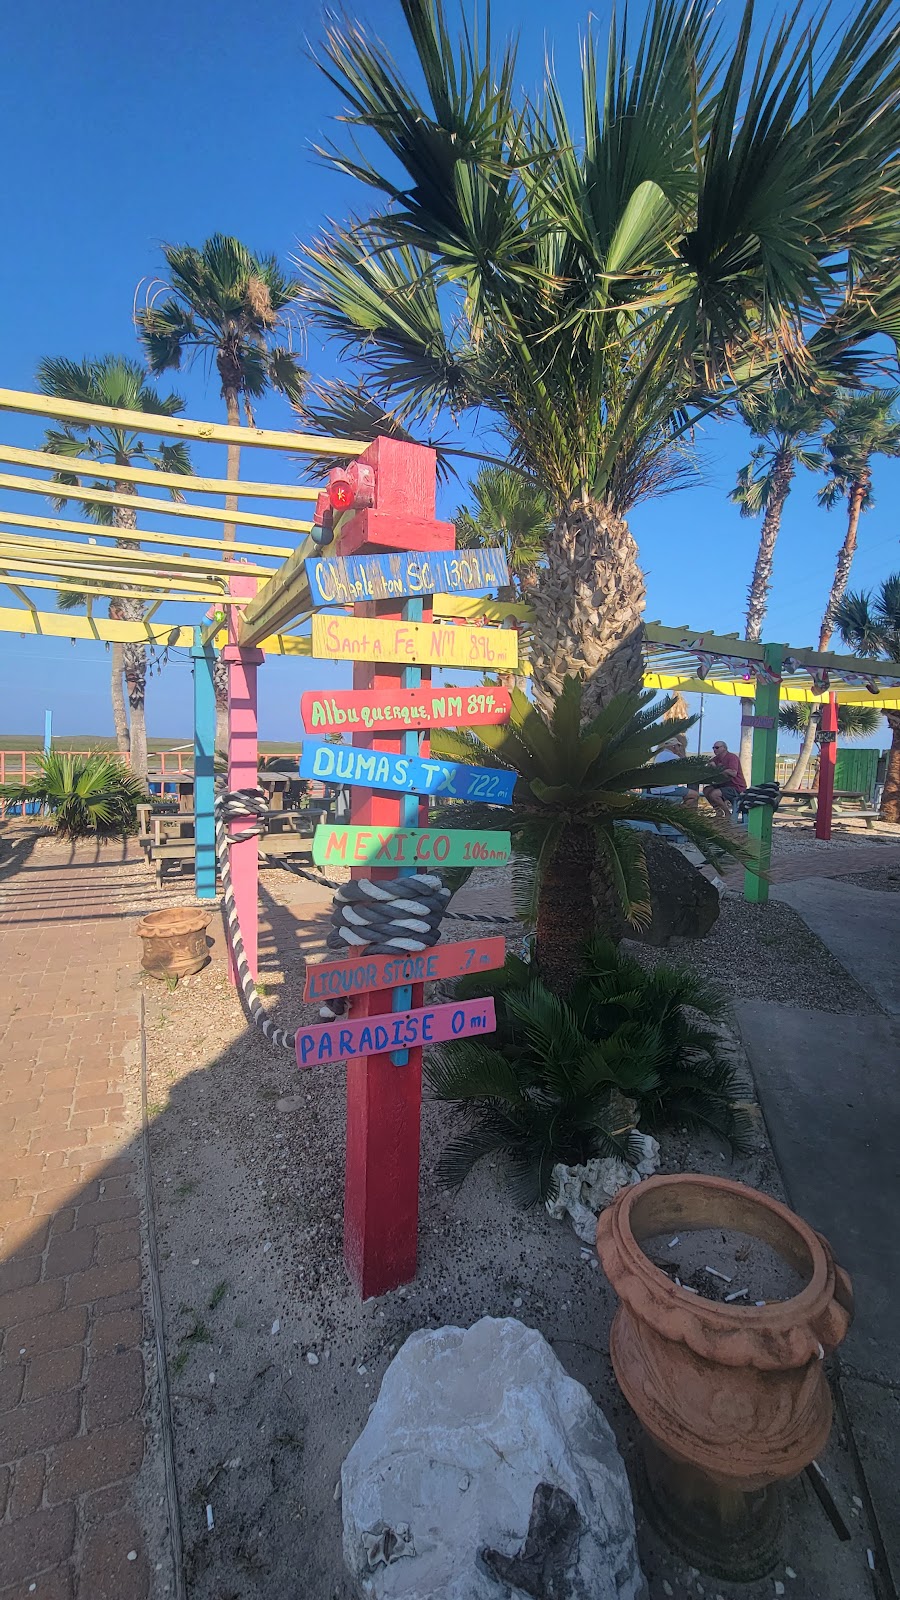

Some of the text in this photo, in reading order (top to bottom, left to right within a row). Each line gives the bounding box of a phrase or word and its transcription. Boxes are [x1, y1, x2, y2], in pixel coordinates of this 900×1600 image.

[407, 562, 435, 591] SC
[430, 630, 455, 657] NM
[469, 635, 495, 661] 896
[497, 648, 507, 661] mi
[432, 696, 462, 719] NM
[467, 694, 495, 715] 894
[495, 703, 507, 714] mi
[312, 747, 509, 798] DUMAS, TX 722 mi
[324, 831, 451, 862] MEXICO
[309, 964, 378, 999] LIQUOR
[382, 955, 440, 984] STORE
[300, 1010, 487, 1064] PARADISE 0 mi
